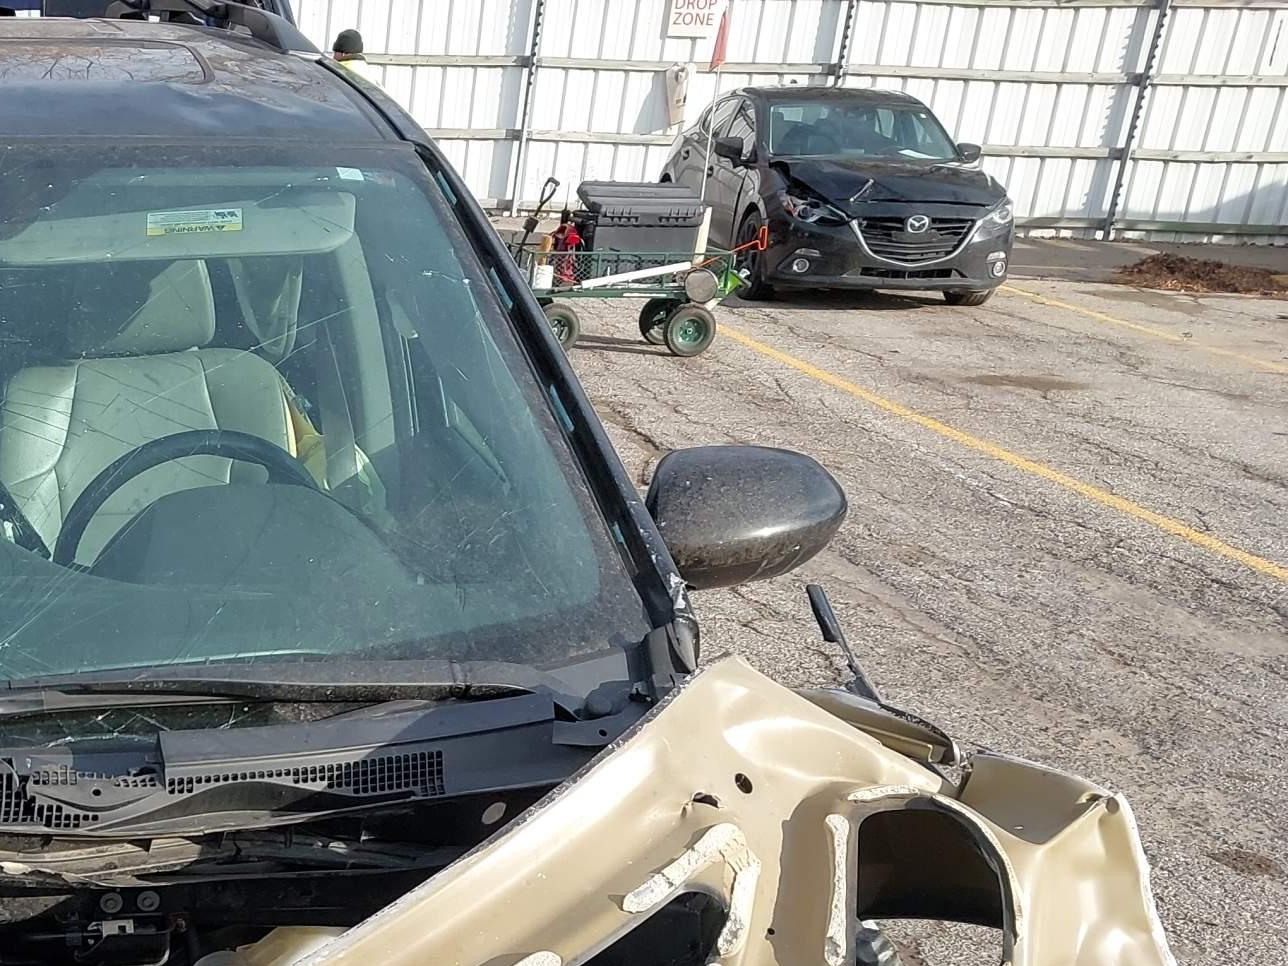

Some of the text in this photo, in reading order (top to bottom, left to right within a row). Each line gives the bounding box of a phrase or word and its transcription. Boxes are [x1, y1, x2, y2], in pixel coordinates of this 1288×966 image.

[674, 0, 718, 10] DROP
[672, 12, 715, 26] ZONE
[164, 224, 215, 234] WARNING
